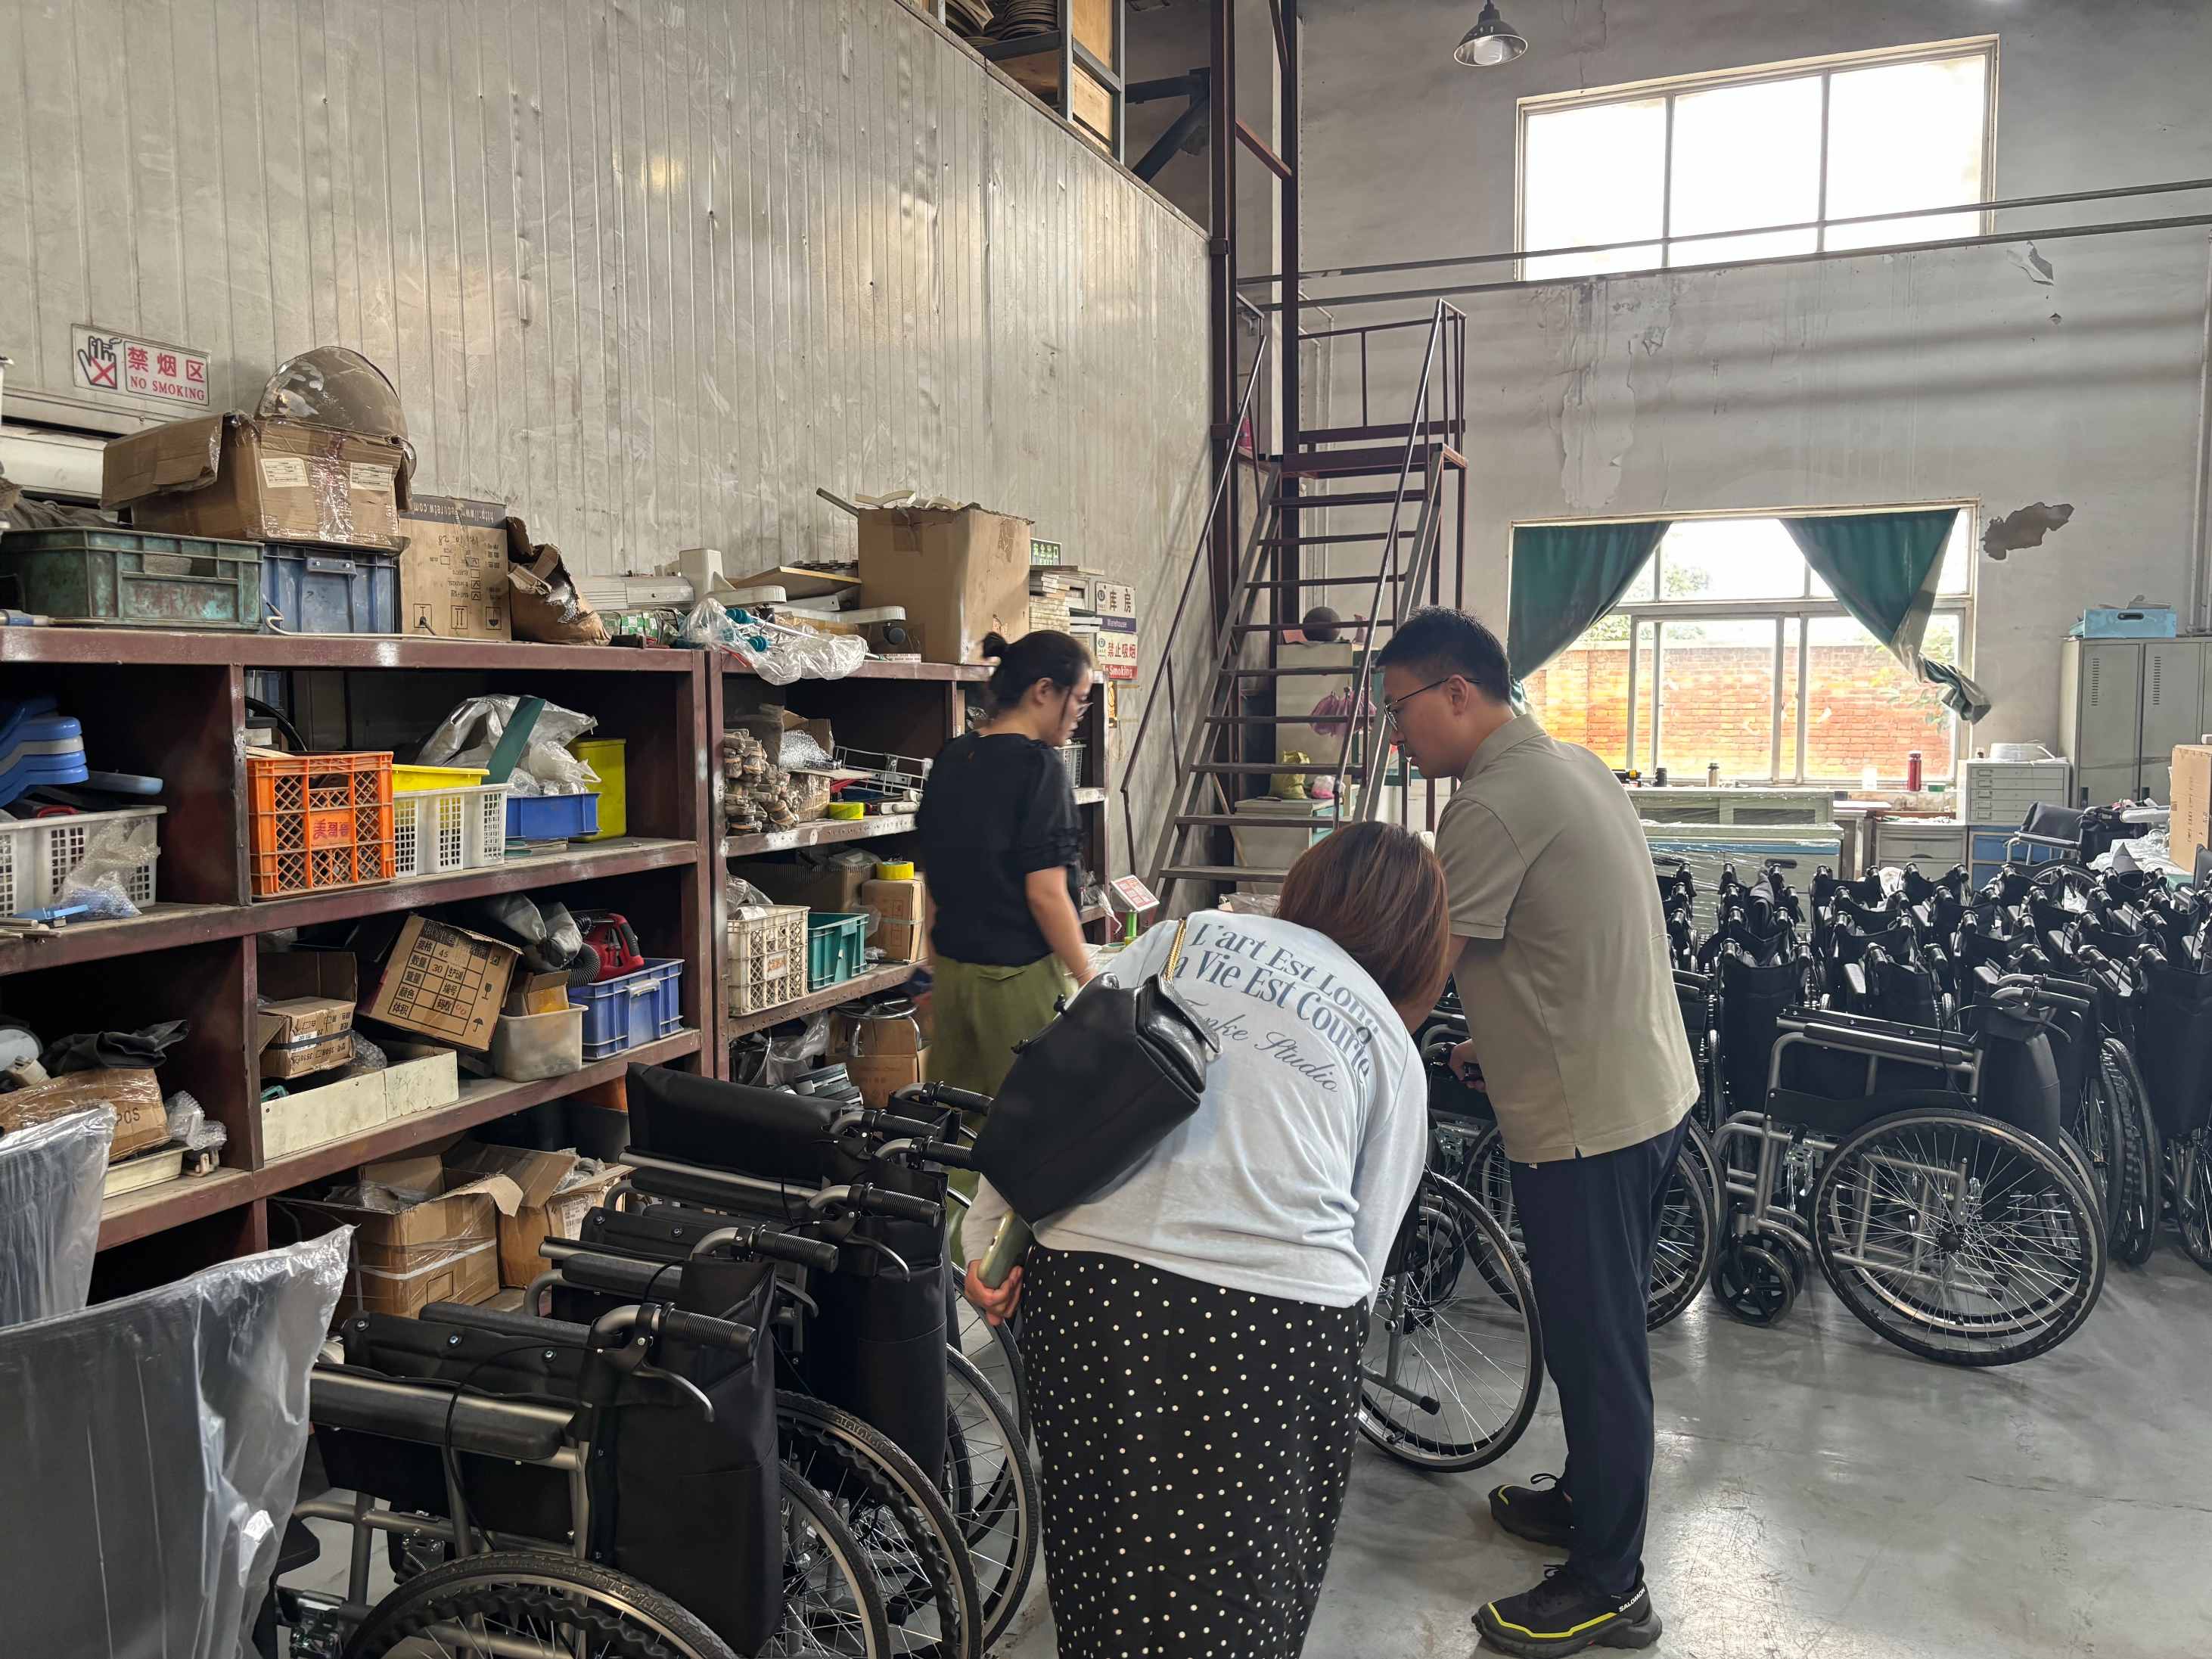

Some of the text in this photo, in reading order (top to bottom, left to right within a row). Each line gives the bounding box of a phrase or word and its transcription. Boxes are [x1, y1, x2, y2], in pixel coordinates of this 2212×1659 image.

[127, 346, 206, 384] 禁烟区
[129, 375, 205, 401] NO SMOKING
[1109, 588, 1132, 614] 库房
[1108, 642, 1136, 659] 禁止吸烟
[1109, 665, 1132, 678] Smoking
[1265, 946, 1318, 983] Est
[1195, 949, 1241, 989] Vie
[1241, 966, 1297, 1010] Est
[1618, 1586, 1646, 1613] SALOMON
